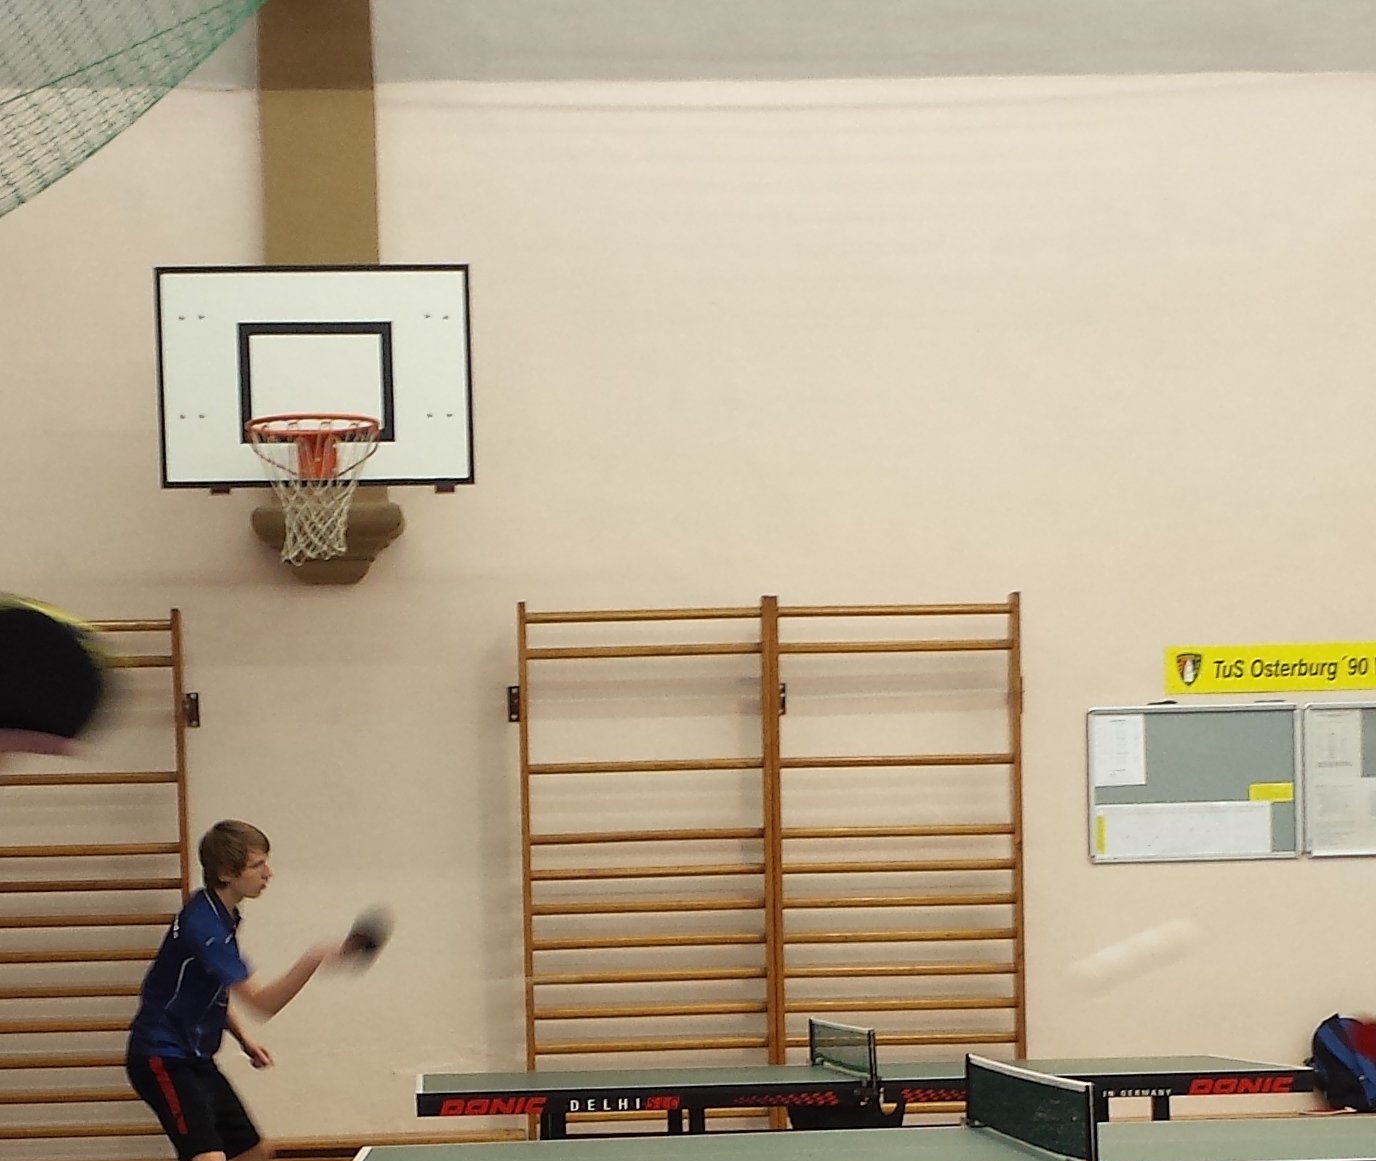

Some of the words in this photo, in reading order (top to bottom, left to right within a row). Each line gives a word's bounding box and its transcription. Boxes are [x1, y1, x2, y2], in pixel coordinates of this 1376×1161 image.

[1213, 660, 1244, 679] TuS
[1250, 656, 1337, 681] Osterburg
[1188, 1076, 1296, 1095] DONIC
[440, 1096, 548, 1116] DONIC
